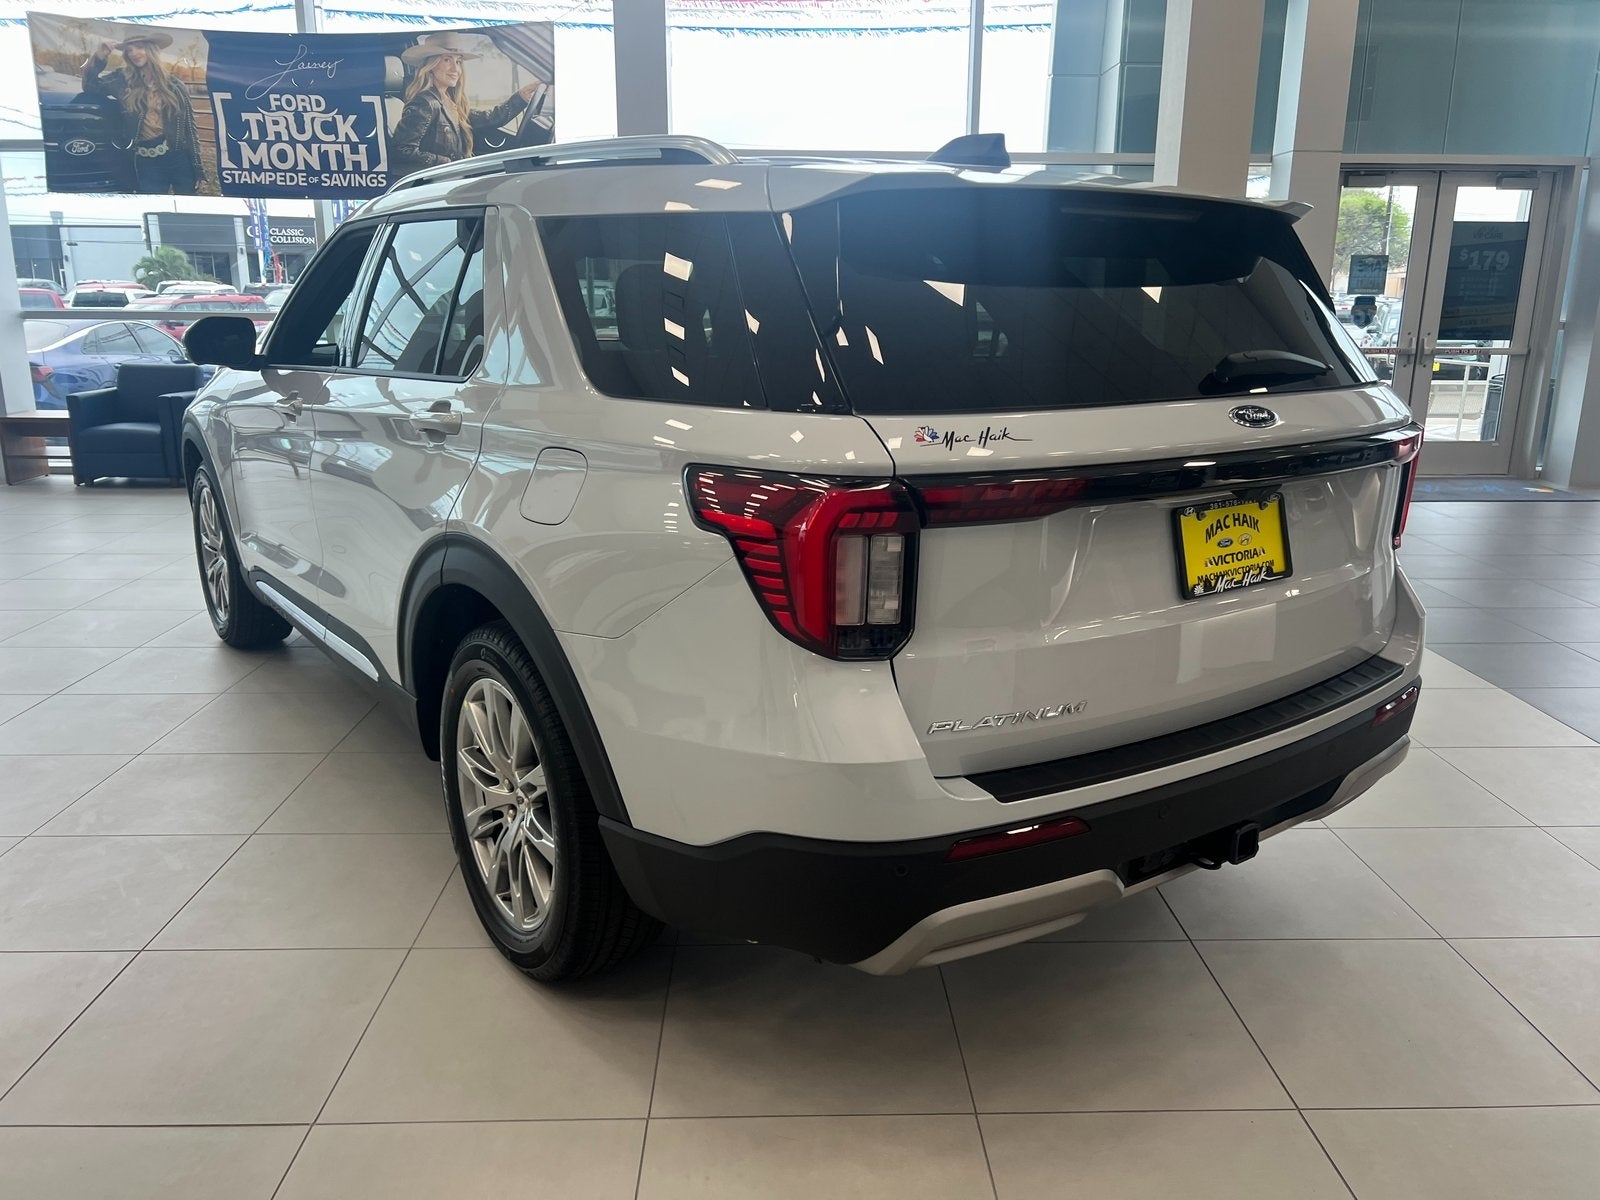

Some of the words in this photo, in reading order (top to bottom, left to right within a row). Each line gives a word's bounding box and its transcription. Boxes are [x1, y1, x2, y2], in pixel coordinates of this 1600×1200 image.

[245, 44, 344, 100] Lainey
[269, 94, 326, 112] FORD
[241, 108, 360, 142] TRUCK
[71, 141, 91, 153] Ford
[238, 142, 367, 171] MONTH
[222, 170, 307, 186] STAMPEDE
[308, 176, 320, 184] OF
[321, 173, 387, 188] SAVINGS
[269, 227, 304, 237] CLASSIC
[270, 235, 316, 244] COLLISION
[1459, 248, 1511, 271] $179
[941, 430, 976, 451] Mac
[978, 426, 1024, 448] Haik
[1205, 514, 1231, 544] MAC
[1232, 512, 1261, 533] HAIK
[1212, 547, 1259, 567] VICTORIA
[1214, 574, 1241, 594] Mac
[1242, 566, 1275, 587] Haik
[927, 700, 1088, 735] PLATINUM
